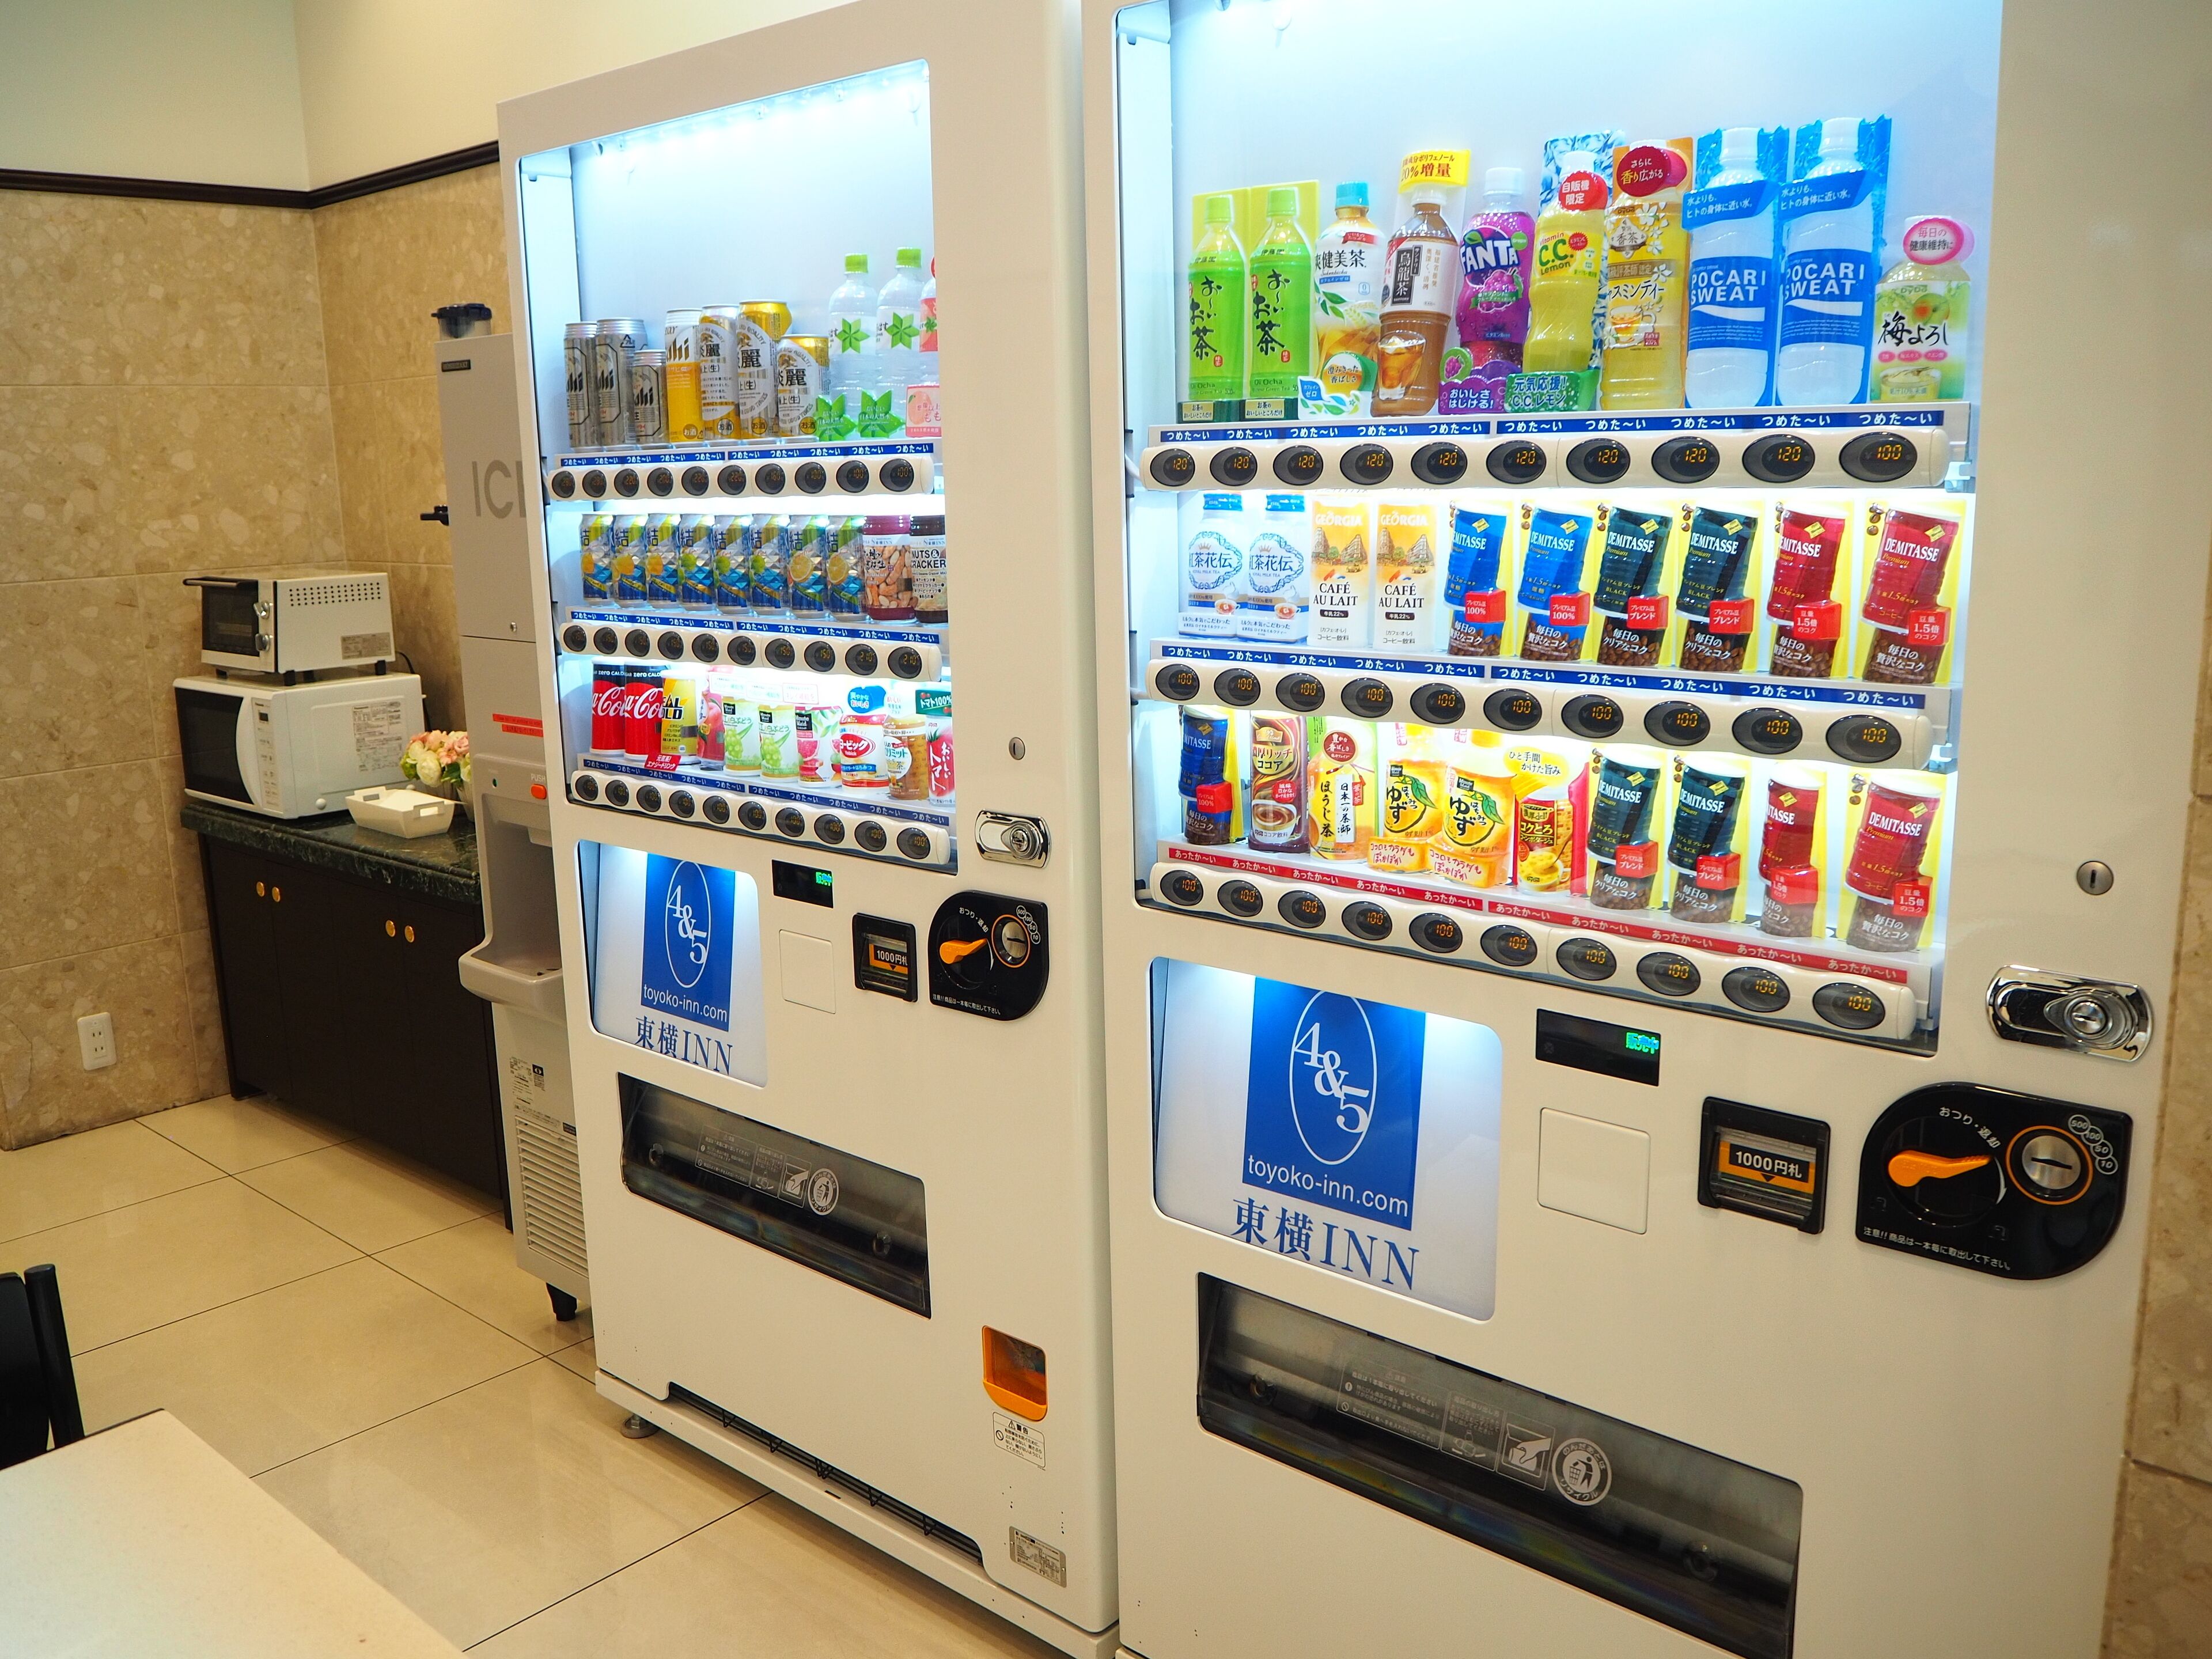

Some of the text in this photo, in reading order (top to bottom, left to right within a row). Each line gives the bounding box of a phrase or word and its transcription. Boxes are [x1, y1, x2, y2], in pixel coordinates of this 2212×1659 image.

[1631, 158, 1652, 168] さらに
[1620, 168, 1663, 185] 香り広がる
[1562, 180, 1590, 193] 自販機
[1565, 193, 1585, 204] 限定
[1539, 232, 1564, 246] Vitamin
[1918, 228, 1946, 238] 毎日の
[1910, 240, 1953, 252] 健康維持に
[1460, 240, 1520, 274] FANTA
[1395, 252, 1411, 296] 烏龍茶
[1540, 261, 1571, 275] Lemon
[1691, 270, 1766, 289] POCARI
[1691, 286, 1759, 305] SWEAT
[1878, 311, 1949, 347] 梅よろし
[1328, 365, 1359, 374] 澄みきった
[1331, 375, 1357, 384] 香ばしさ
[1450, 389, 1491, 399] おいしさ
[1246, 409, 1283, 417] おいしいところだけ
[801, 421, 816, 430] お酒
[1440, 452, 1457, 465] 120
[1599, 449, 1618, 463] 120
[1778, 446, 1801, 461] 120
[1877, 445, 1901, 460] 100
[1173, 458, 1188, 469] 120
[1299, 455, 1314, 468] 120
[472, 459, 527, 520] IC
[1316, 511, 1363, 527] GEORGIA
[1381, 511, 1429, 527] GEORGIA
[1530, 532, 1575, 552] DEMITASSE
[1607, 532, 1655, 554] DEMITASSE
[1690, 532, 1738, 555] DEMITASSE
[1884, 537, 1940, 562] DEMITASSE
[1882, 553, 1910, 565] Premium
[1319, 582, 1350, 594] CAFÉ
[1385, 584, 1416, 596] CAFÉ
[1605, 586, 1628, 597] BLACK
[1688, 589, 1710, 600] BLACK
[1313, 596, 1358, 606] AU LAIT
[1379, 597, 1425, 608] AU LAIT
[1467, 607, 1486, 615] 100%
[1630, 611, 1656, 620] ブレンド
[1797, 617, 1817, 627] 1.5倍
[1914, 622, 1940, 634] 1.5倍
[1536, 624, 1562, 638] 毎日の
[1613, 628, 1639, 643] 毎日の
[1915, 632, 1937, 641] のコク
[1528, 632, 1567, 649] 贅沢なコク
[1603, 637, 1648, 655] クリアなコク
[1684, 642, 1731, 660] クリアなコク
[1888, 643, 1919, 660] 毎日の
[1876, 652, 1925, 672] 贅沢なコク
[1238, 679, 1252, 690] 100
[1438, 694, 1455, 707] 100
[1677, 713, 1698, 727] 100
[1862, 728, 1887, 743] 100
[1509, 751, 1541, 763] ひと手間
[1257, 760, 1283, 771] ココア
[1521, 764, 1560, 775] かけた旨み
[1320, 781, 1334, 838] ほうじ茶
[1450, 796, 1475, 836] ゆず
[1520, 821, 1554, 835] コクとろ
[1869, 811, 1923, 837] DEMITASSE
[1604, 873, 1629, 889] 毎日の
[1240, 890, 1255, 902] 100
[1595, 879, 1638, 900] クリアなコク
[1899, 896, 1925, 907] 1.5倍
[1435, 923, 1453, 938] 100
[1862, 921, 1910, 941] 贅沢なコク
[1668, 964, 1690, 979] 100
[643, 984, 728, 1023] toyoko-inn.com
[1848, 996, 1872, 1011] 100
[635, 1015, 733, 1076] 東横INN
[1626, 1032, 1659, 1054] 販売中
[2070, 1119, 2088, 1130] 500
[2085, 1131, 2101, 1141] 100
[2093, 1144, 2109, 1154] 50
[1735, 1149, 1802, 1179] 1000円札
[2101, 1160, 2113, 1169] 10
[1247, 1154, 1408, 1217] toyoko-inn.com
[1230, 1197, 1419, 1290] 東横INN
